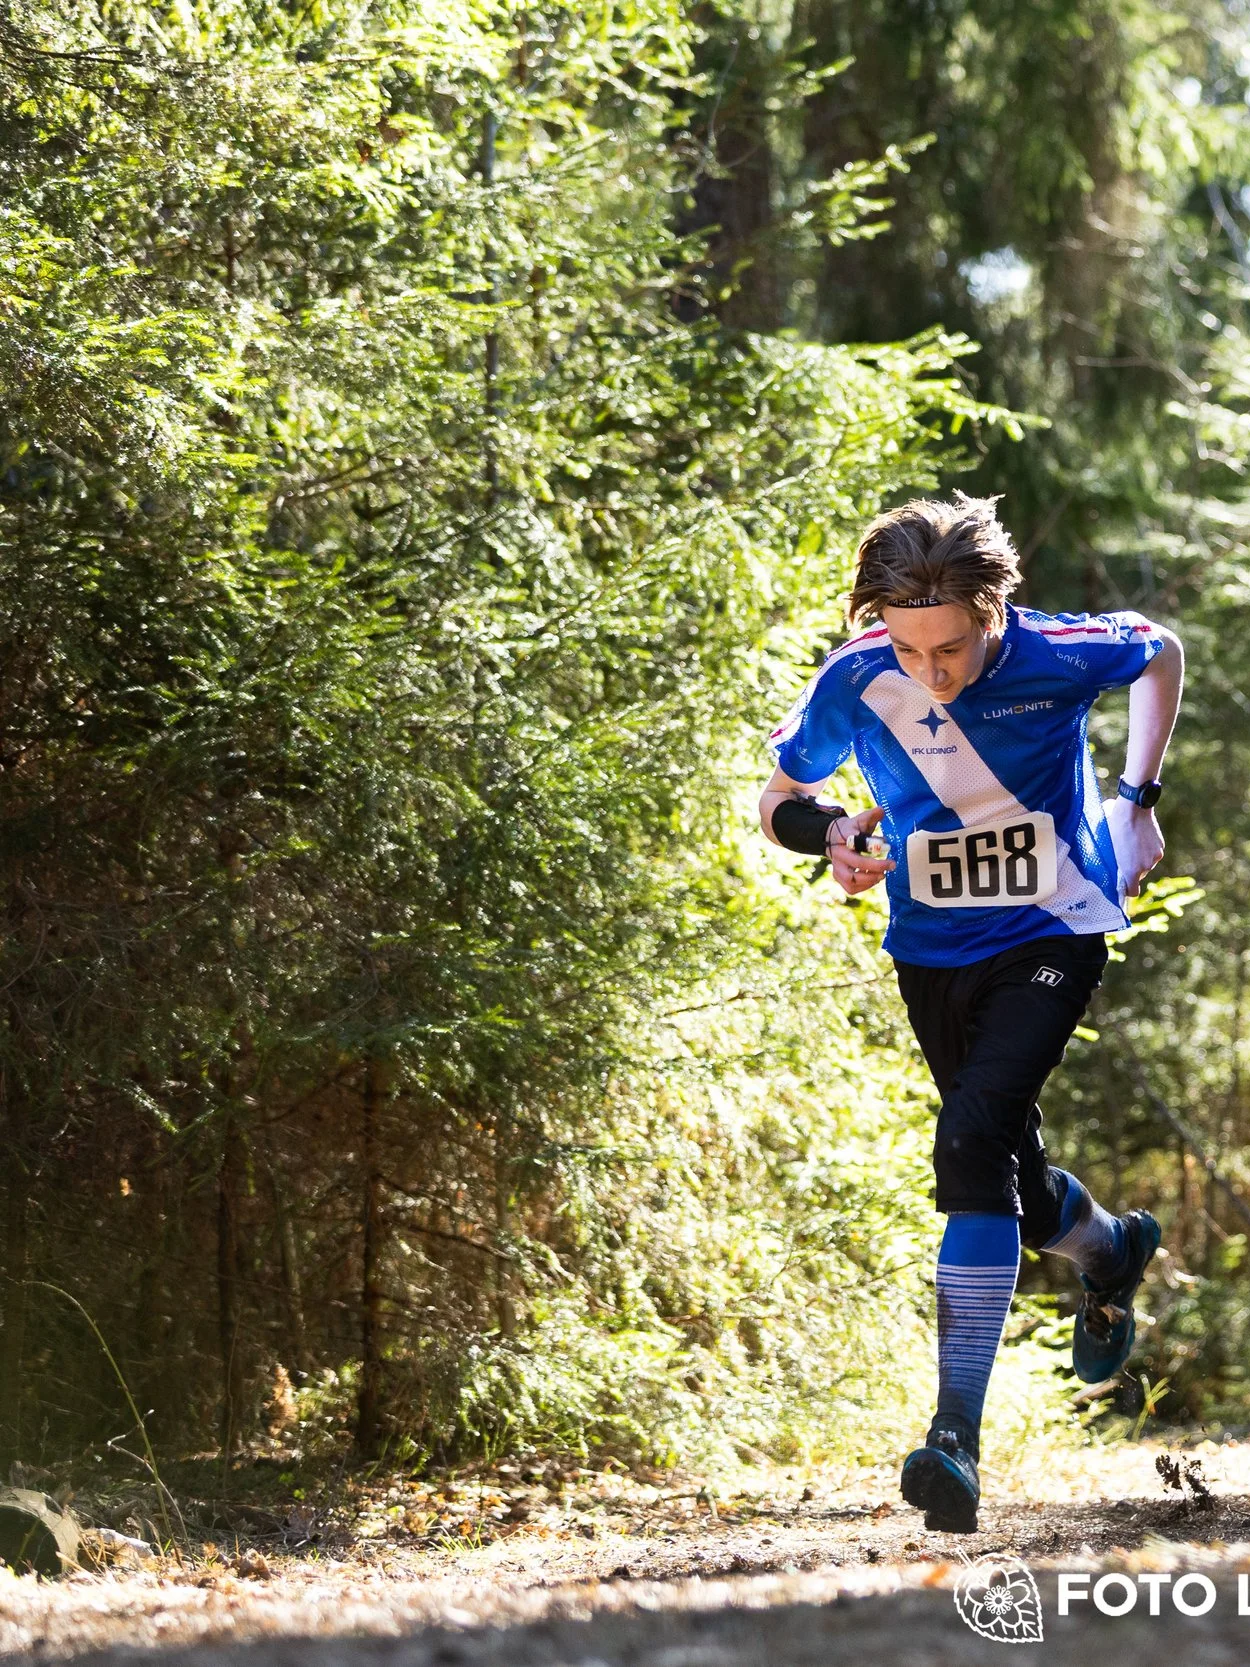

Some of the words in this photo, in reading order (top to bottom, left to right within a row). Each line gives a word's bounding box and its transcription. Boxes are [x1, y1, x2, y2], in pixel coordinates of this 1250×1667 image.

[889, 596, 938, 606] MONITE
[983, 700, 1054, 719] LUMONITE
[911, 747, 925, 755] IFK
[928, 822, 1038, 899] 568
